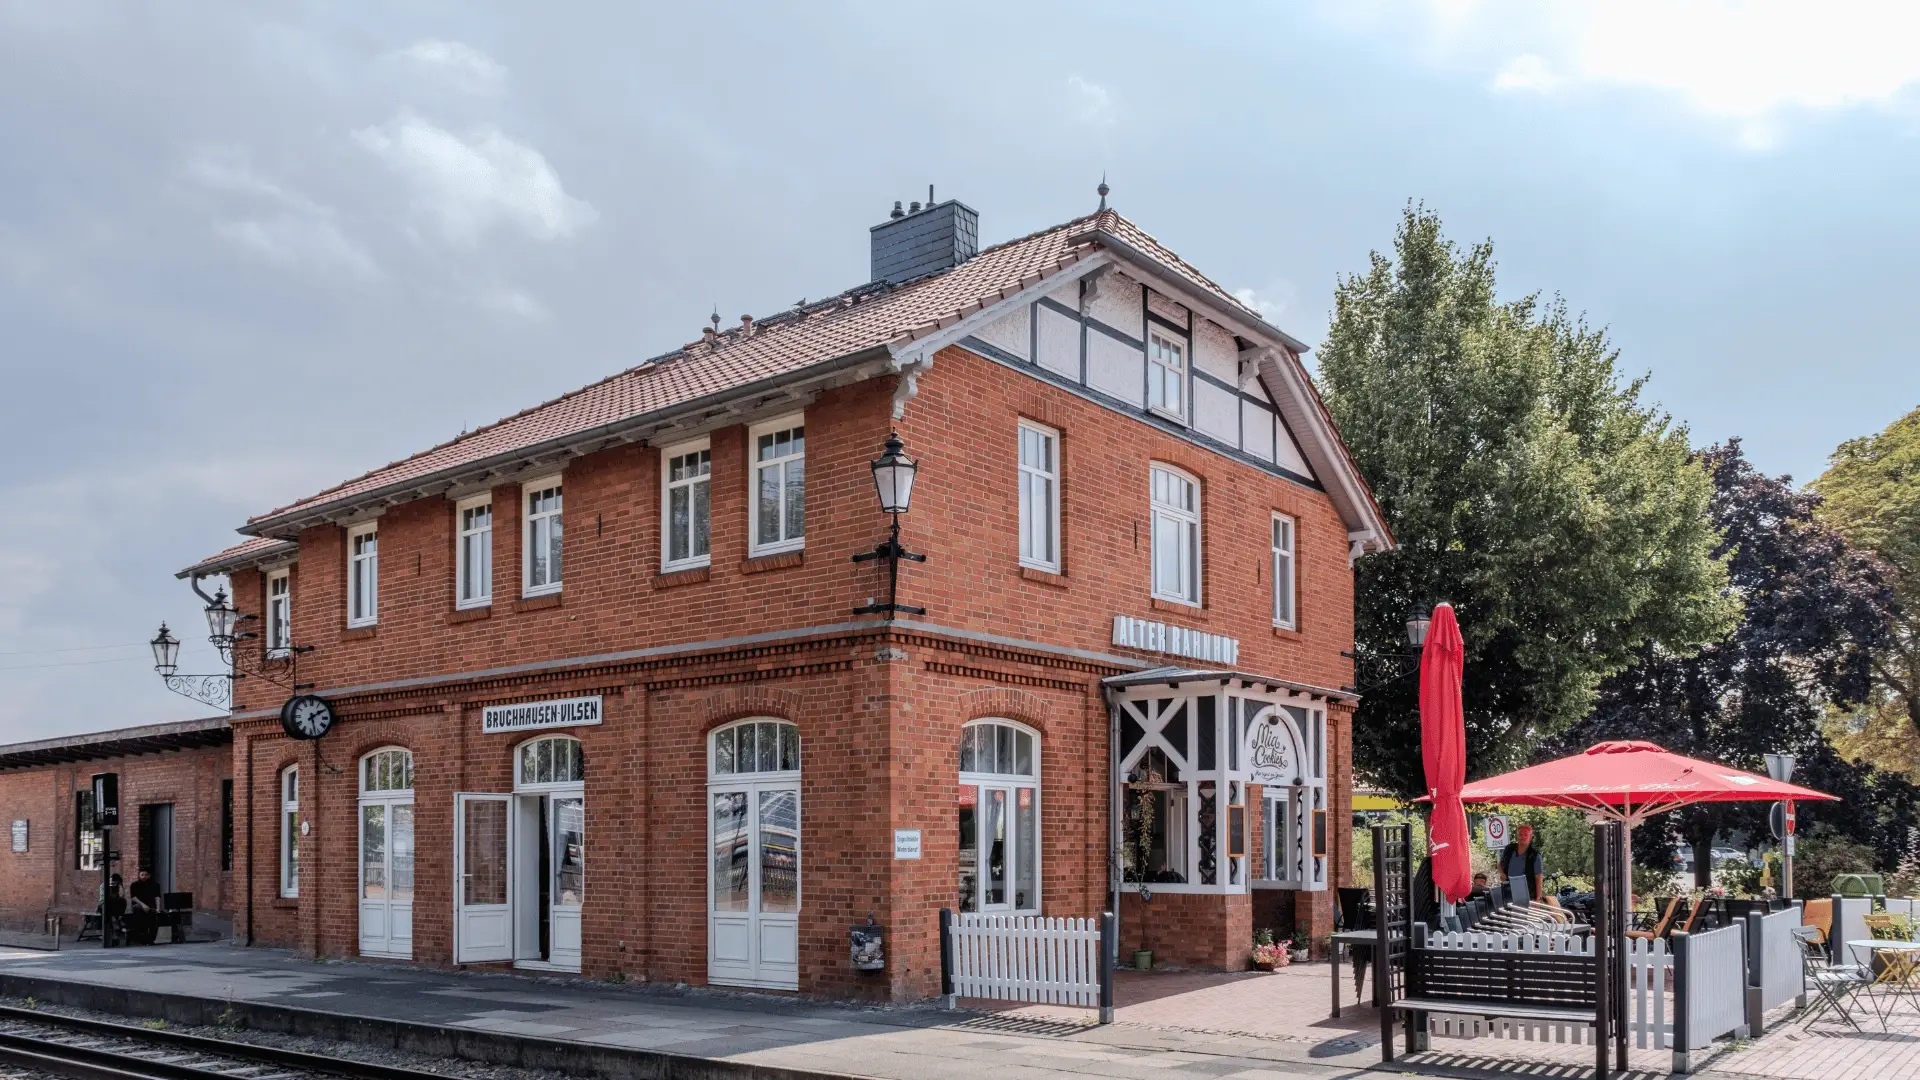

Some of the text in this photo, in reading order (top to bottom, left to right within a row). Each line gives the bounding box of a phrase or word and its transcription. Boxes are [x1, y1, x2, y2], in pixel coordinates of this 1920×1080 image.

[1117, 615, 1240, 666] ALTER BAHNHOF
[486, 700, 598, 729] BRUCHHAUSEN-VILSEN
[1492, 823, 1501, 834] 30
